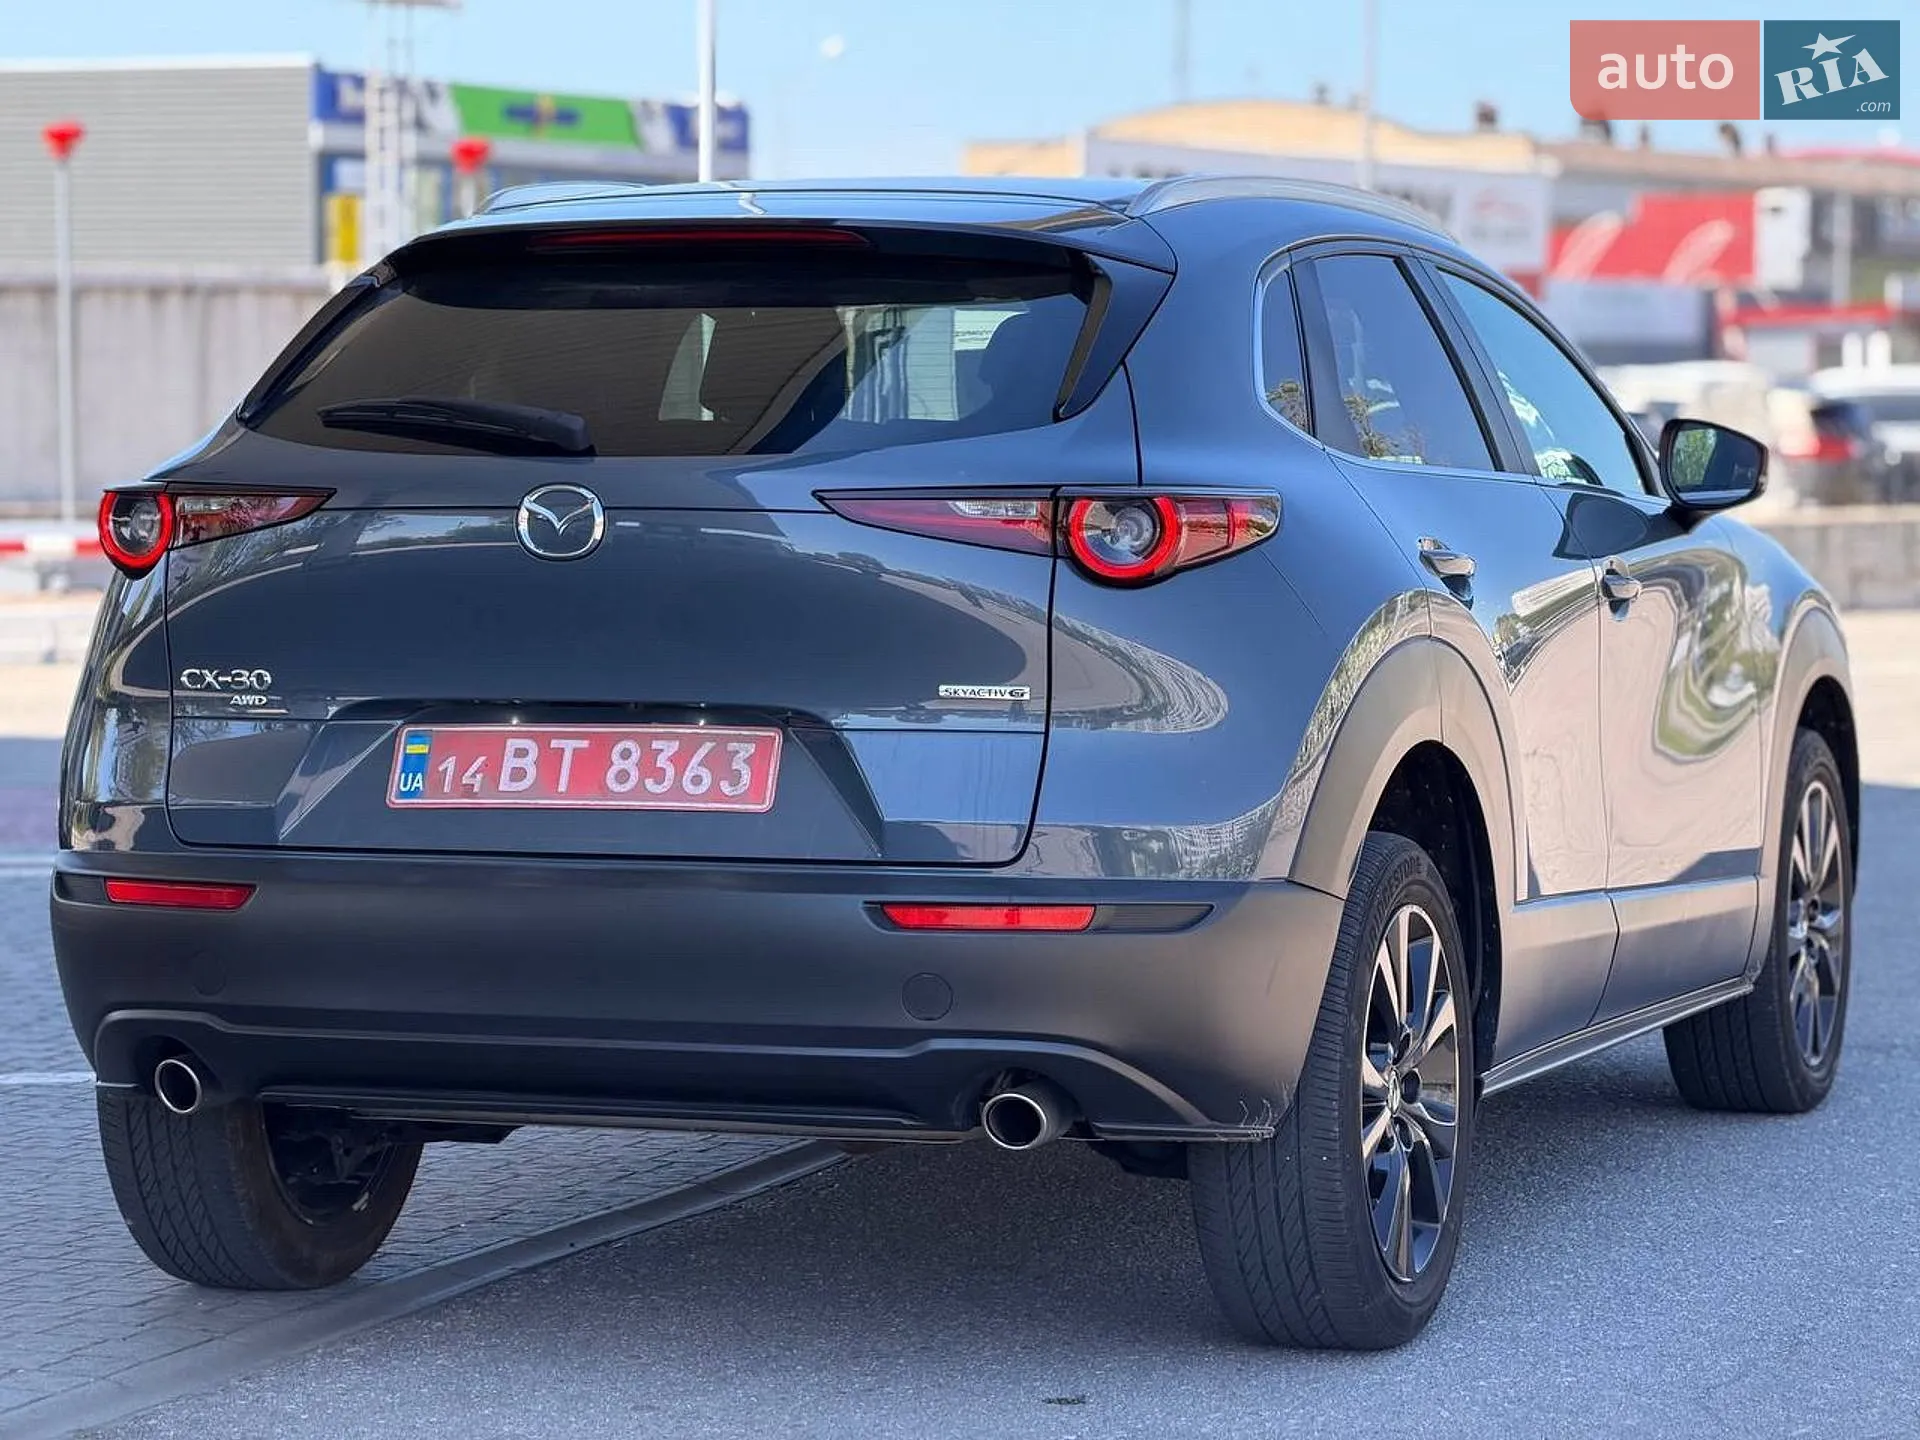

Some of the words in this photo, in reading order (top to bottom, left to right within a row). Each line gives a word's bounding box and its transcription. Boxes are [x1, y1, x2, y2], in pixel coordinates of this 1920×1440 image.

[180, 669, 272, 690] CX-30
[230, 695, 267, 705] AWD
[438, 756, 488, 793] 14
[498, 738, 590, 793] BT
[605, 739, 756, 796] 8363
[400, 772, 424, 792] UA
